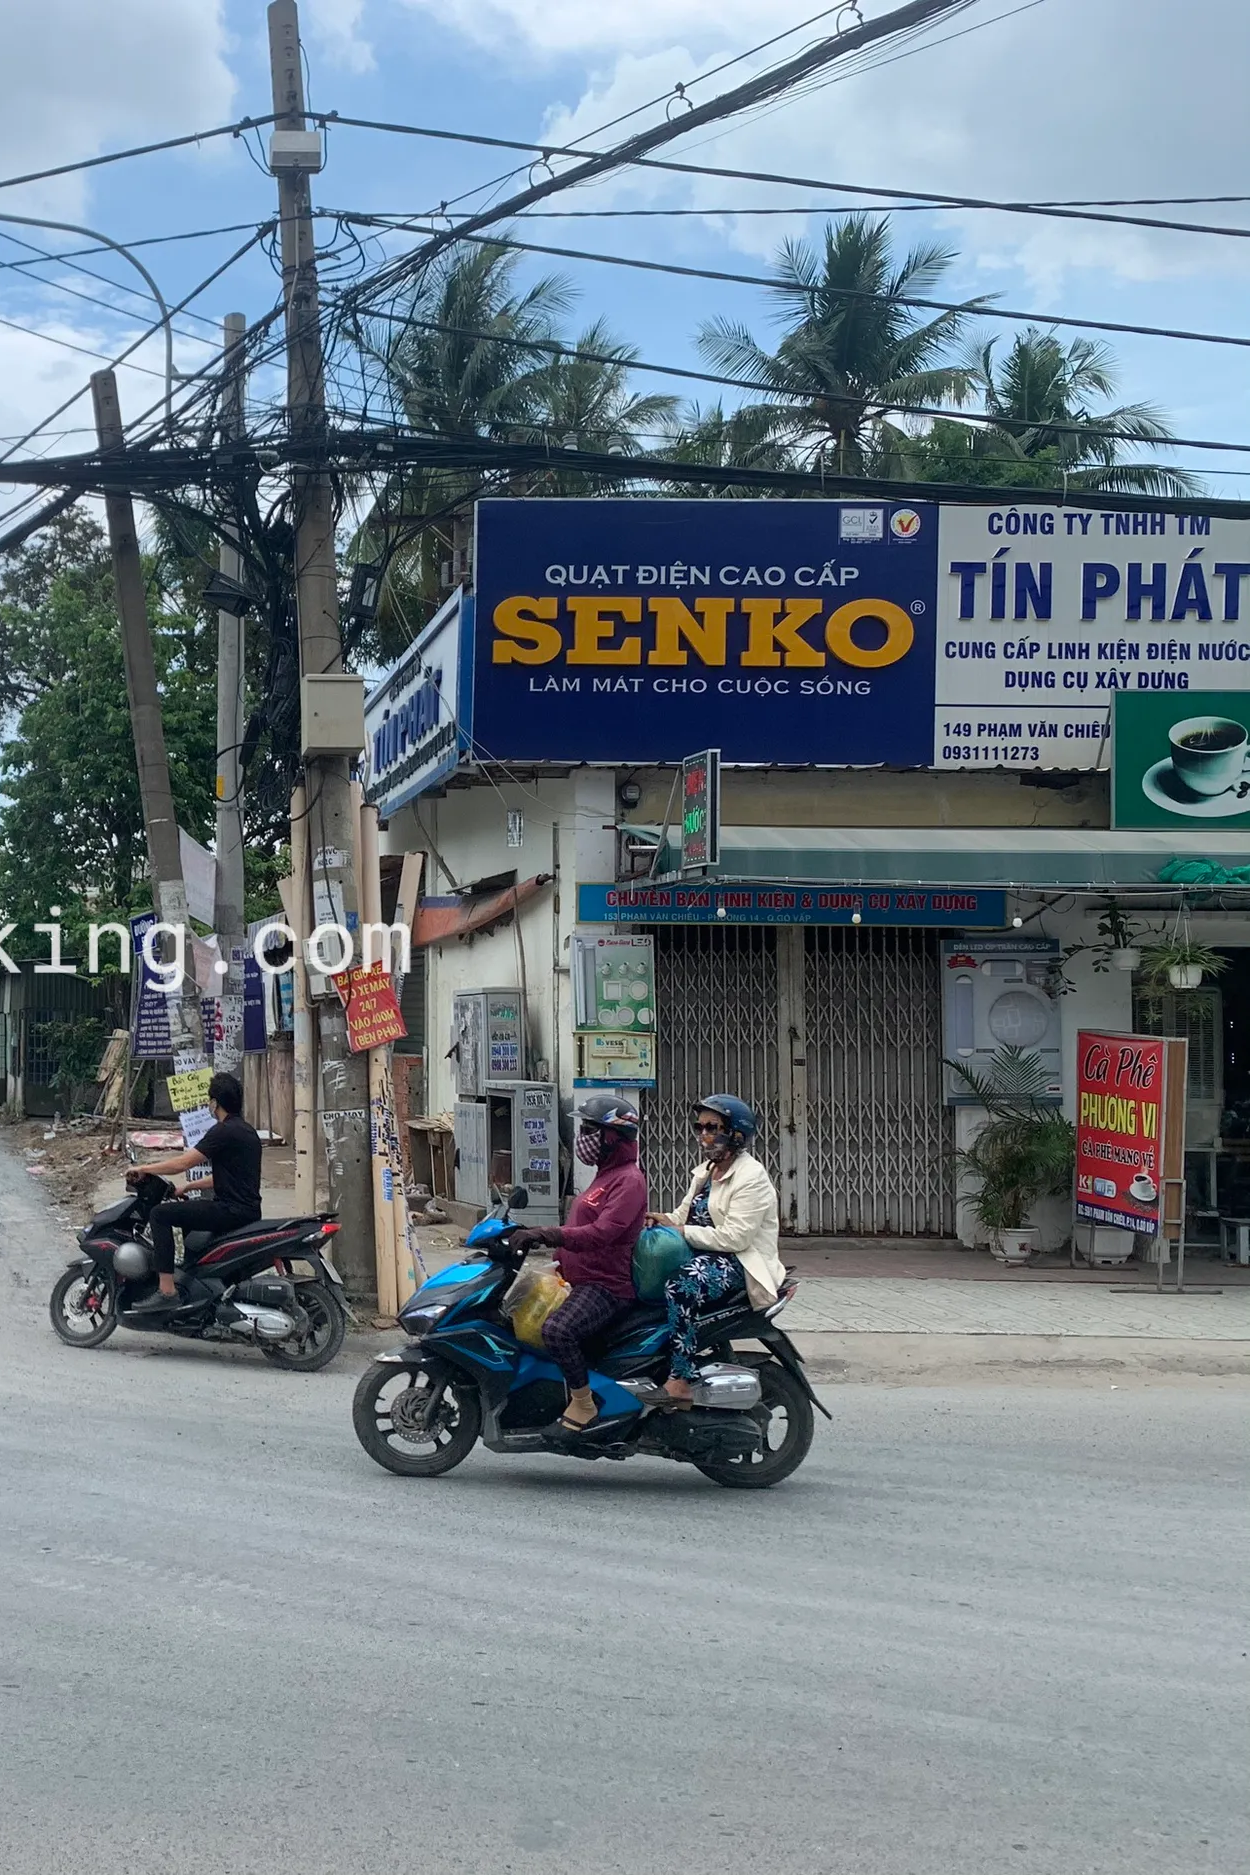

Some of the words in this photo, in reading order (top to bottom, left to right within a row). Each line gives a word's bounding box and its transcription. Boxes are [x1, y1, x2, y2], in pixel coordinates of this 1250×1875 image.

[988, 508, 1055, 536] CÔNG
[1063, 513, 1093, 536] TY
[1100, 513, 1166, 536] TNHH
[1174, 514, 1211, 536] TM
[545, 564, 630, 589] QUẠT
[636, 560, 711, 590] ĐIỆN
[719, 565, 786, 586] CAO
[794, 558, 860, 587] CẤP
[949, 547, 1053, 621] TÍN
[1080, 547, 1250, 621] PHÁT
[492, 595, 915, 668] SENKO
[945, 641, 996, 660] CUNG
[1003, 635, 1041, 660] CẤP
[1047, 642, 1090, 660] LINH
[1097, 638, 1140, 664] KIỆN
[1146, 638, 1191, 664] ĐIỆN
[1198, 639, 1250, 662] NƯỚC
[529, 675, 582, 693] LÀM
[592, 674, 645, 693] MÁT
[652, 678, 708, 695] CHO
[717, 676, 791, 697] CUỘC
[799, 674, 873, 696] SỐNG
[1005, 671, 1056, 692] DỤNG
[1063, 671, 1089, 693] CỤ
[1095, 668, 1132, 689] XÂY
[943, 722, 971, 737] 149
[977, 723, 1023, 741] PHẠM
[1028, 721, 1058, 738] VĂN
[942, 746, 1040, 761] 0931111273
[606, 888, 672, 908] CHUYÊN
[676, 889, 711, 908] BÁN
[757, 889, 796, 911] KIỆN
[800, 893, 814, 909] &
[868, 893, 891, 912] CỤ
[895, 891, 927, 910] XÂY
[1084, 1043, 1111, 1084] Cà
[1115, 1046, 1158, 1089] Phê
[1080, 1091, 1137, 1136] PHƯƠNG
